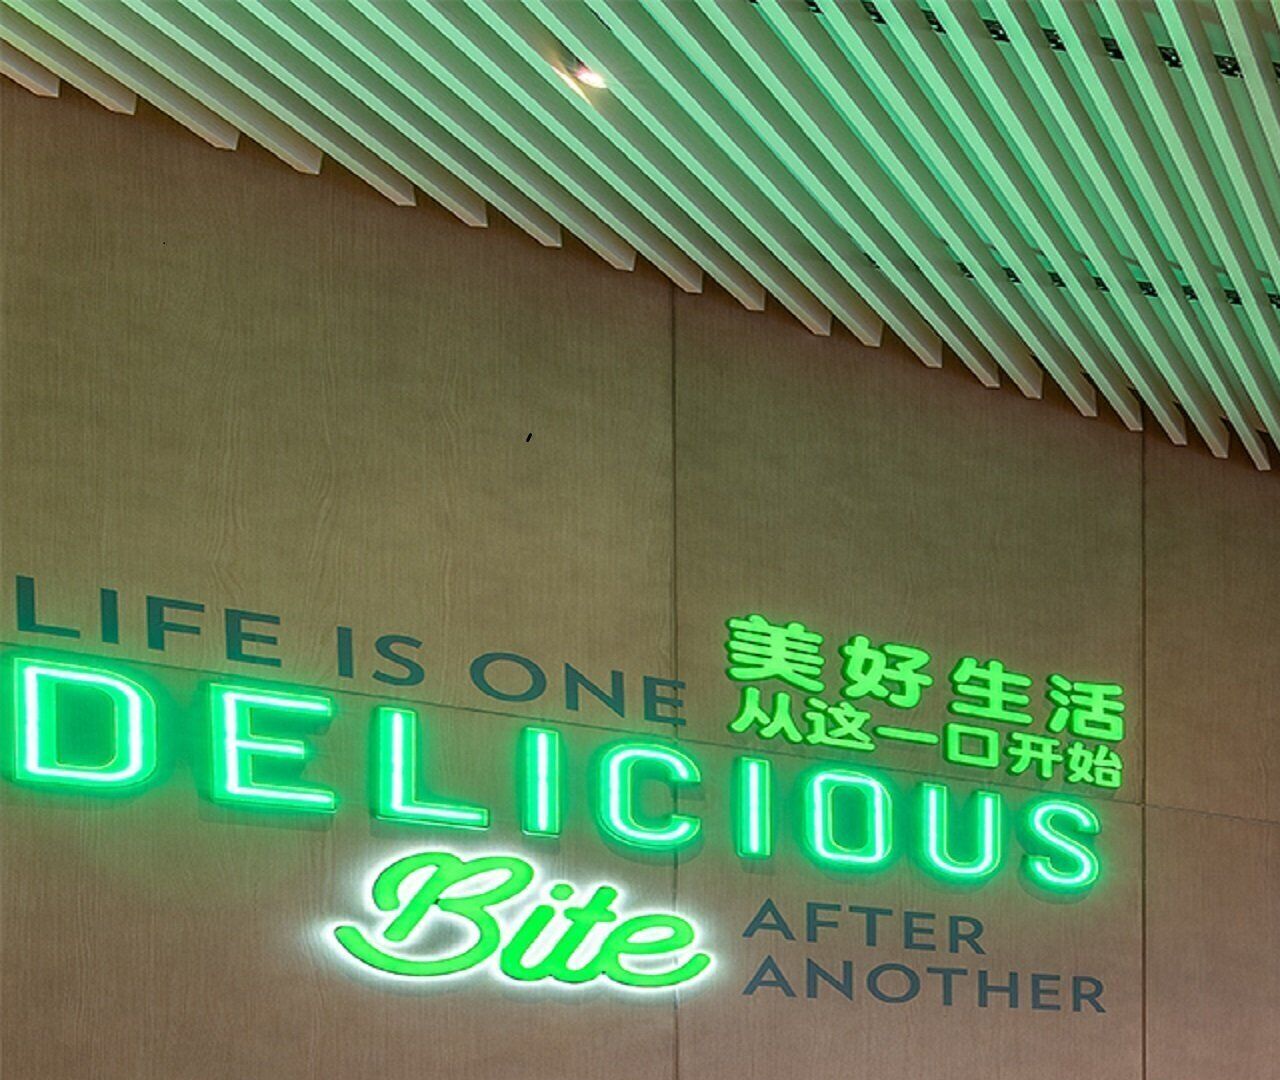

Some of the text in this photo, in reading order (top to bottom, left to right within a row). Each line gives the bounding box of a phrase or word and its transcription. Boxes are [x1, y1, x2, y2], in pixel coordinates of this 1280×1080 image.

[15, 574, 687, 727] LIFE IS ONE
[725, 614, 1124, 742] 美好生活
[13, 656, 1101, 887] DELICIOUS
[728, 686, 1124, 789] 从这一口开始
[333, 851, 711, 988] Bite
[741, 897, 987, 956] AFTER
[741, 954, 1107, 1014] ANOTHER
